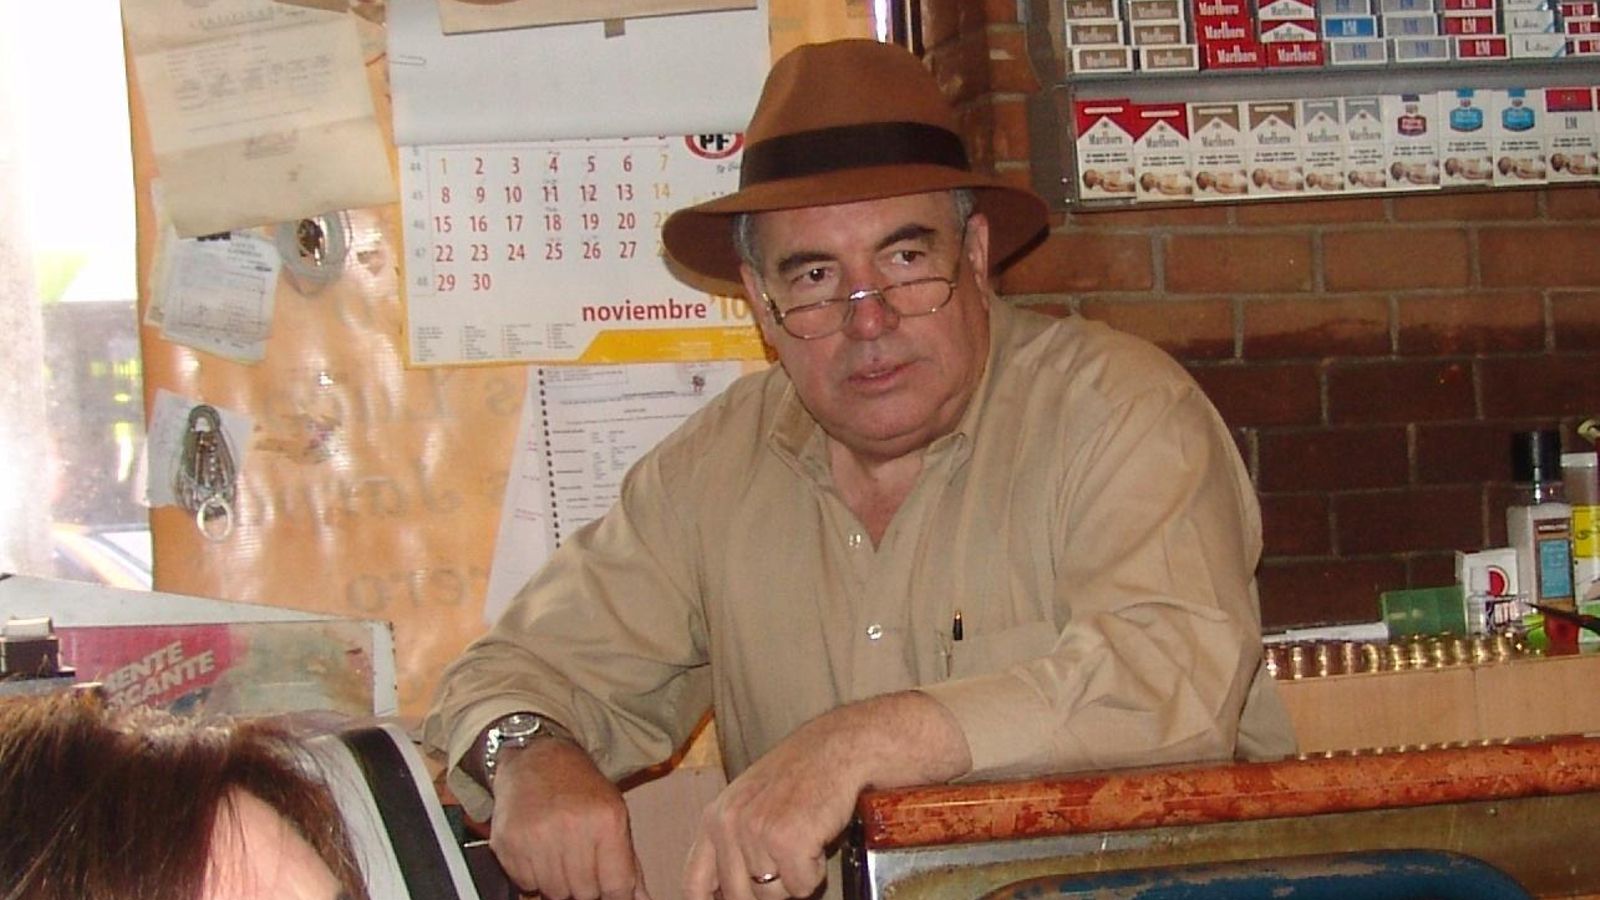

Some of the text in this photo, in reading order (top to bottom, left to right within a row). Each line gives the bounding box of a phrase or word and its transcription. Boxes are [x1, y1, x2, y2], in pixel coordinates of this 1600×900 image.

[1199, 0, 1239, 15] Marlboro
[1205, 21, 1245, 38] Marlboro
[1217, 45, 1257, 62] Marlboro
[1278, 44, 1317, 62] Marlboro
[1088, 131, 1123, 145] Marlboro
[1145, 134, 1179, 148] Marlboro
[1201, 133, 1235, 147] Marlboro
[1257, 132, 1290, 144] Marlboro
[1307, 128, 1339, 142] Marlboro
[1349, 127, 1381, 140] Marlboro
[440, 157, 447, 174] 1
[475, 157, 484, 175] 2
[511, 156, 520, 175] 3
[549, 156, 558, 173] 4
[587, 155, 596, 173] 5
[623, 155, 633, 172] 6
[660, 153, 669, 171] 7
[441, 186, 451, 204] 8
[476, 186, 486, 204] 9
[505, 185, 522, 203] 10
[542, 185, 559, 202] 11
[580, 184, 597, 202] 12
[617, 183, 634, 201] 13
[653, 183, 671, 199] 14
[434, 215, 452, 233] 15
[469, 215, 488, 233] 16
[506, 214, 523, 232] 17
[544, 213, 562, 231] 18
[581, 213, 599, 230] 19
[617, 212, 636, 230] 20
[435, 244, 454, 263] 22
[471, 243, 489, 262] 23
[508, 243, 525, 261] 24
[545, 242, 563, 261] 25
[582, 241, 601, 260] 26
[619, 240, 637, 259] 27
[437, 273, 456, 292] 29
[473, 273, 491, 291] 30
[582, 298, 707, 322] noviembre
